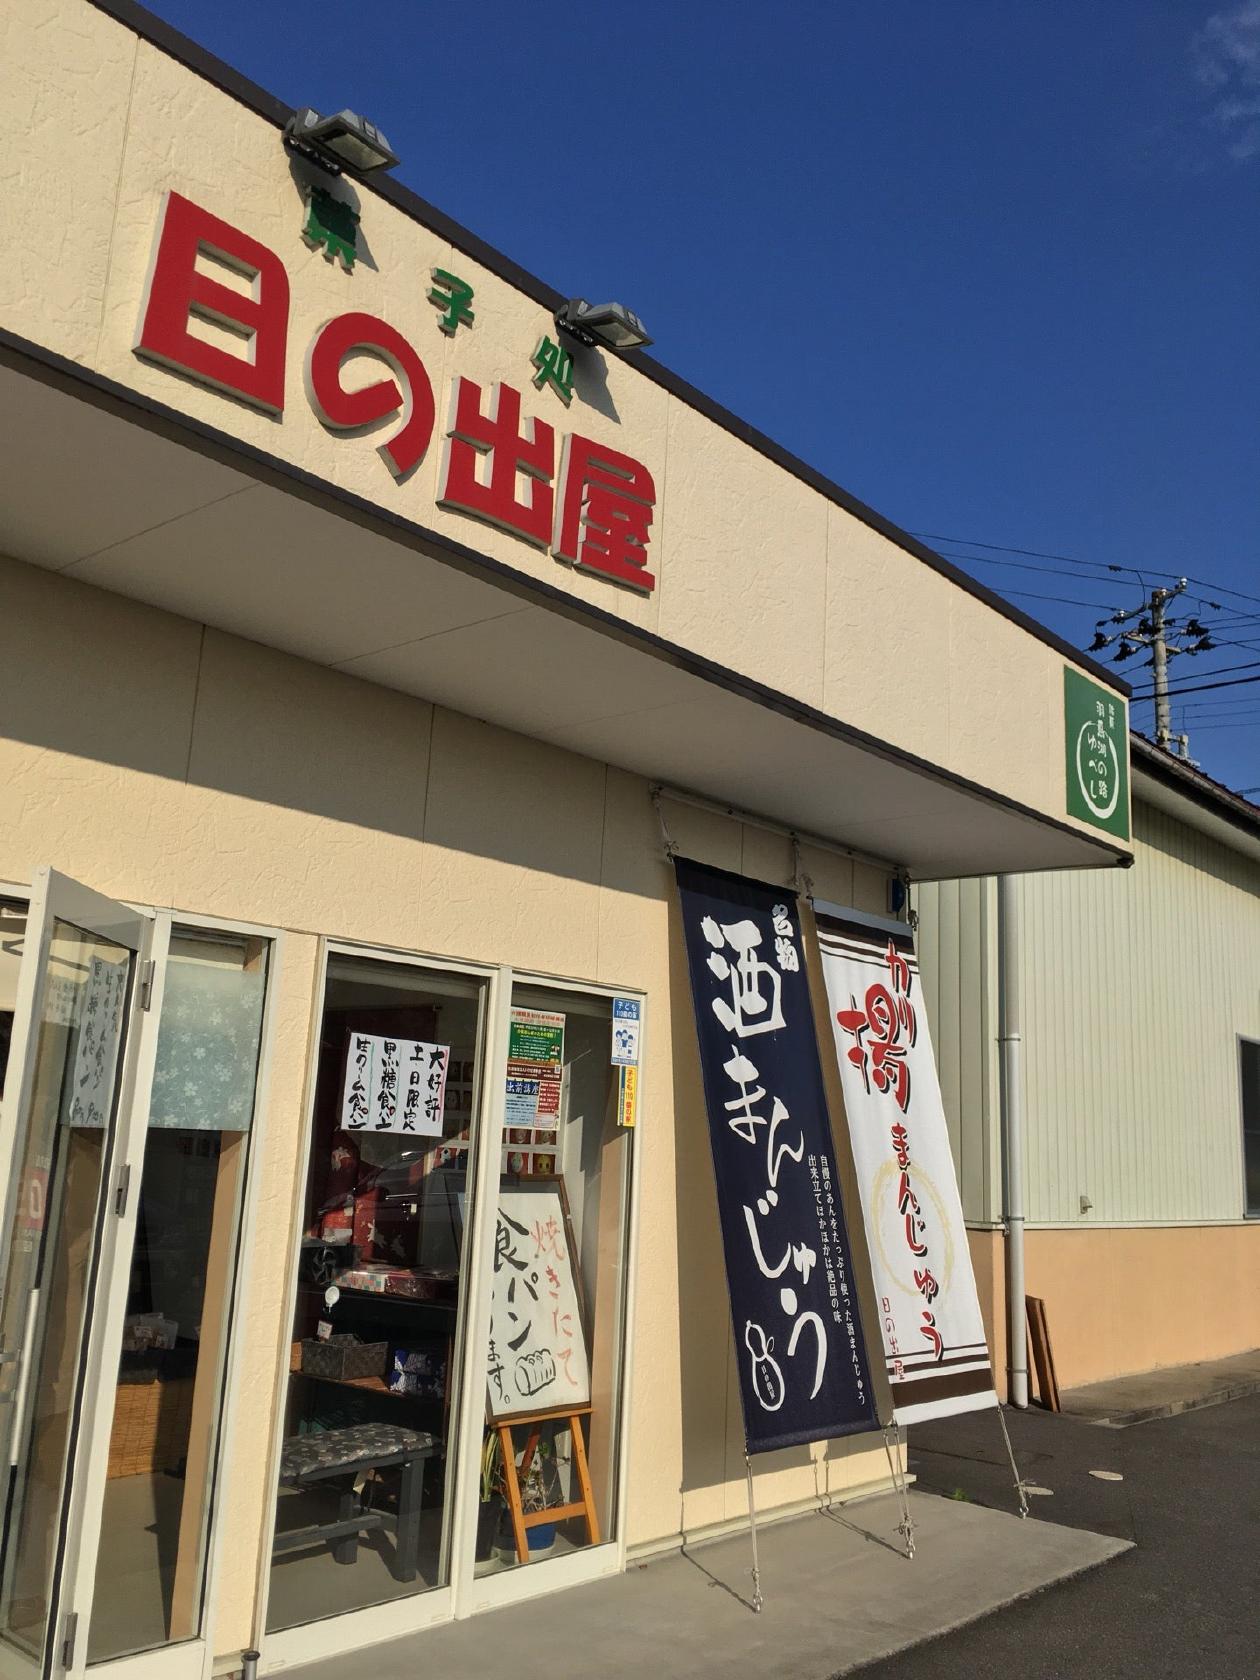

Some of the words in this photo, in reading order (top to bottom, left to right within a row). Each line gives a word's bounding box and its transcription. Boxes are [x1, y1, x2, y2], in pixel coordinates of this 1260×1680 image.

[301, 186, 575, 408] 菓子処
[132, 190, 656, 598] 日の出屋
[1087, 731, 1098, 799] ゆべし
[772, 904, 799, 972] 名物
[425, 1046, 445, 1122] 大好評
[700, 914, 828, 1402] 酒まんじゅう
[494, 1207, 539, 1351] 食パン
[530, 1215, 578, 1386] 焼きたて
[820, 1154, 865, 1406] 自慢のあんをたっぷり使った酒まんじゅう
[882, 1297, 905, 1380] 日の出屋
